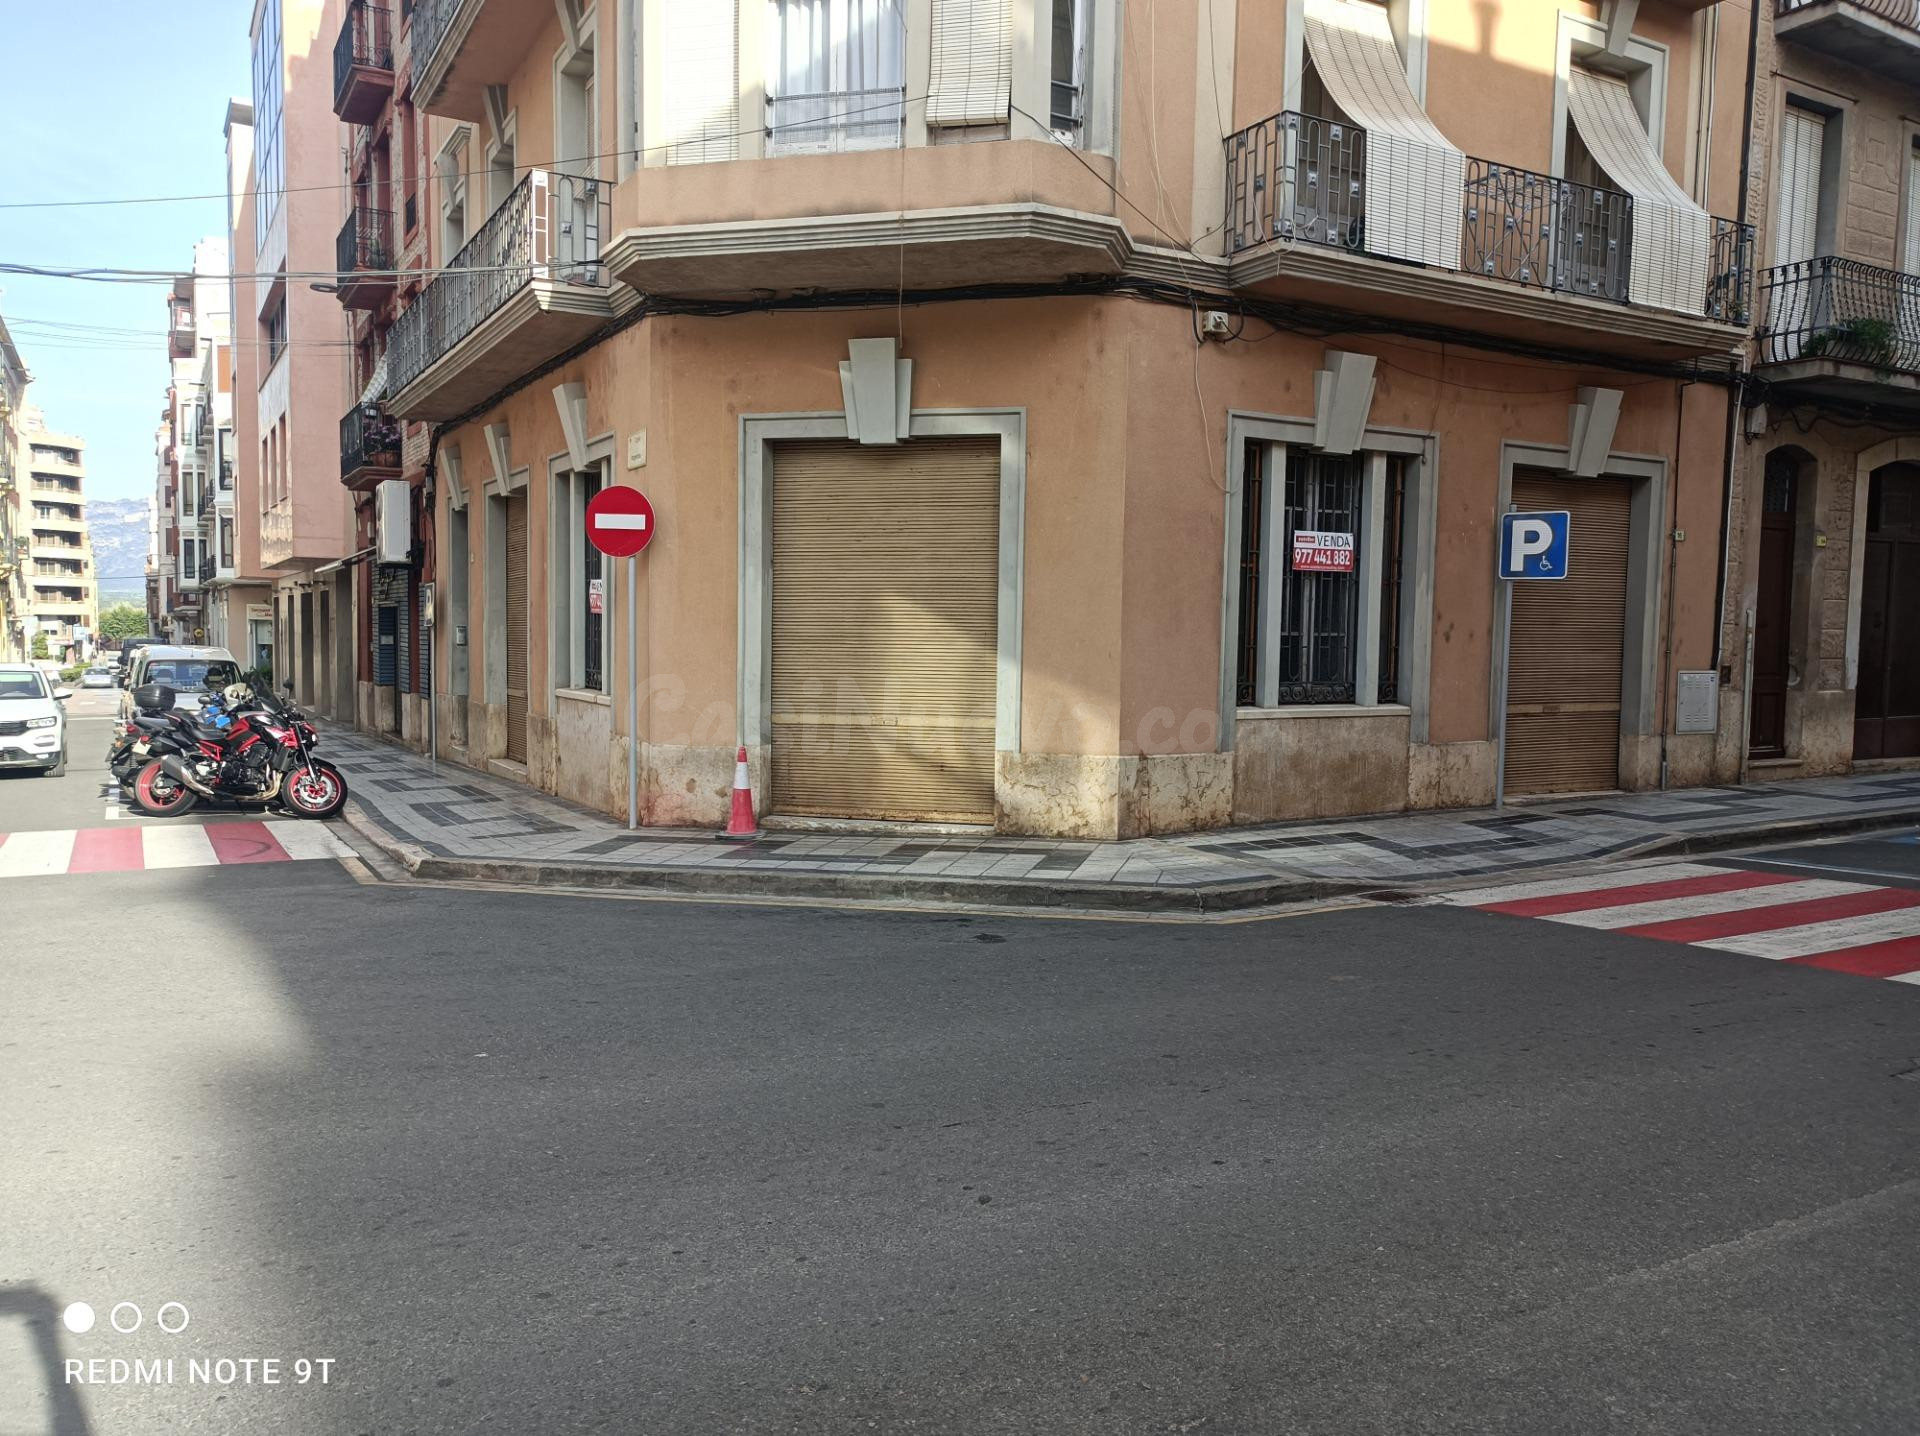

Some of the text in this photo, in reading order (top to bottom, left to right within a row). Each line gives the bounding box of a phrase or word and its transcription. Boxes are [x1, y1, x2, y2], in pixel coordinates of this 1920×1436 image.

[1316, 534, 1351, 548] VENDA
[1510, 519, 1553, 572] P
[1295, 548, 1351, 565] 977 441 882
